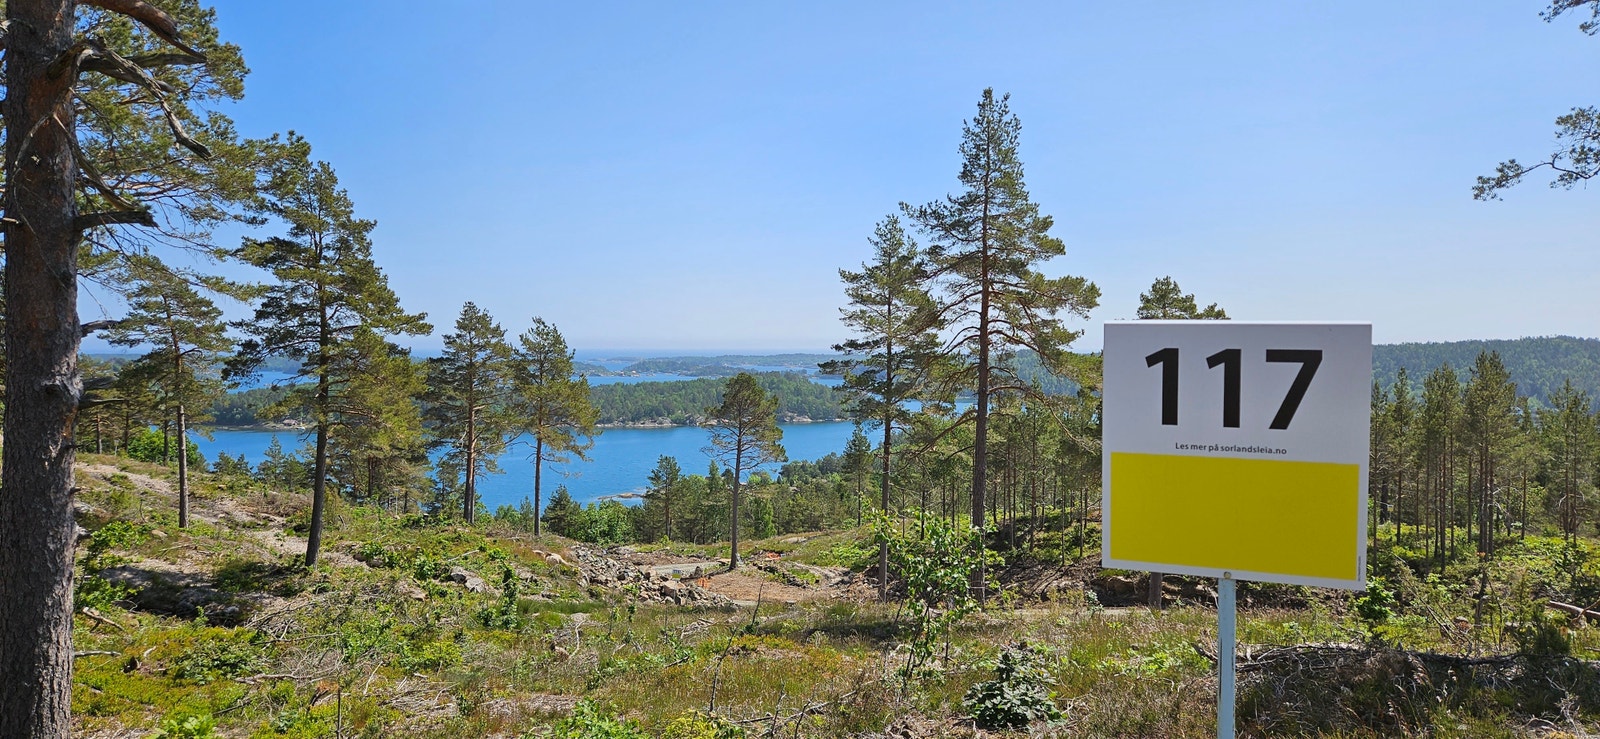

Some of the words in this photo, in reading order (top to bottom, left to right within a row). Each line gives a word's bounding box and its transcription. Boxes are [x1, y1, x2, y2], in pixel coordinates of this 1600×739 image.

[1145, 347, 1323, 430] 117
[1175, 442, 1189, 450] Les
[1190, 443, 1207, 451] mer
[1208, 443, 1219, 453] på
[1220, 444, 1288, 455] sorlandsleia.no
